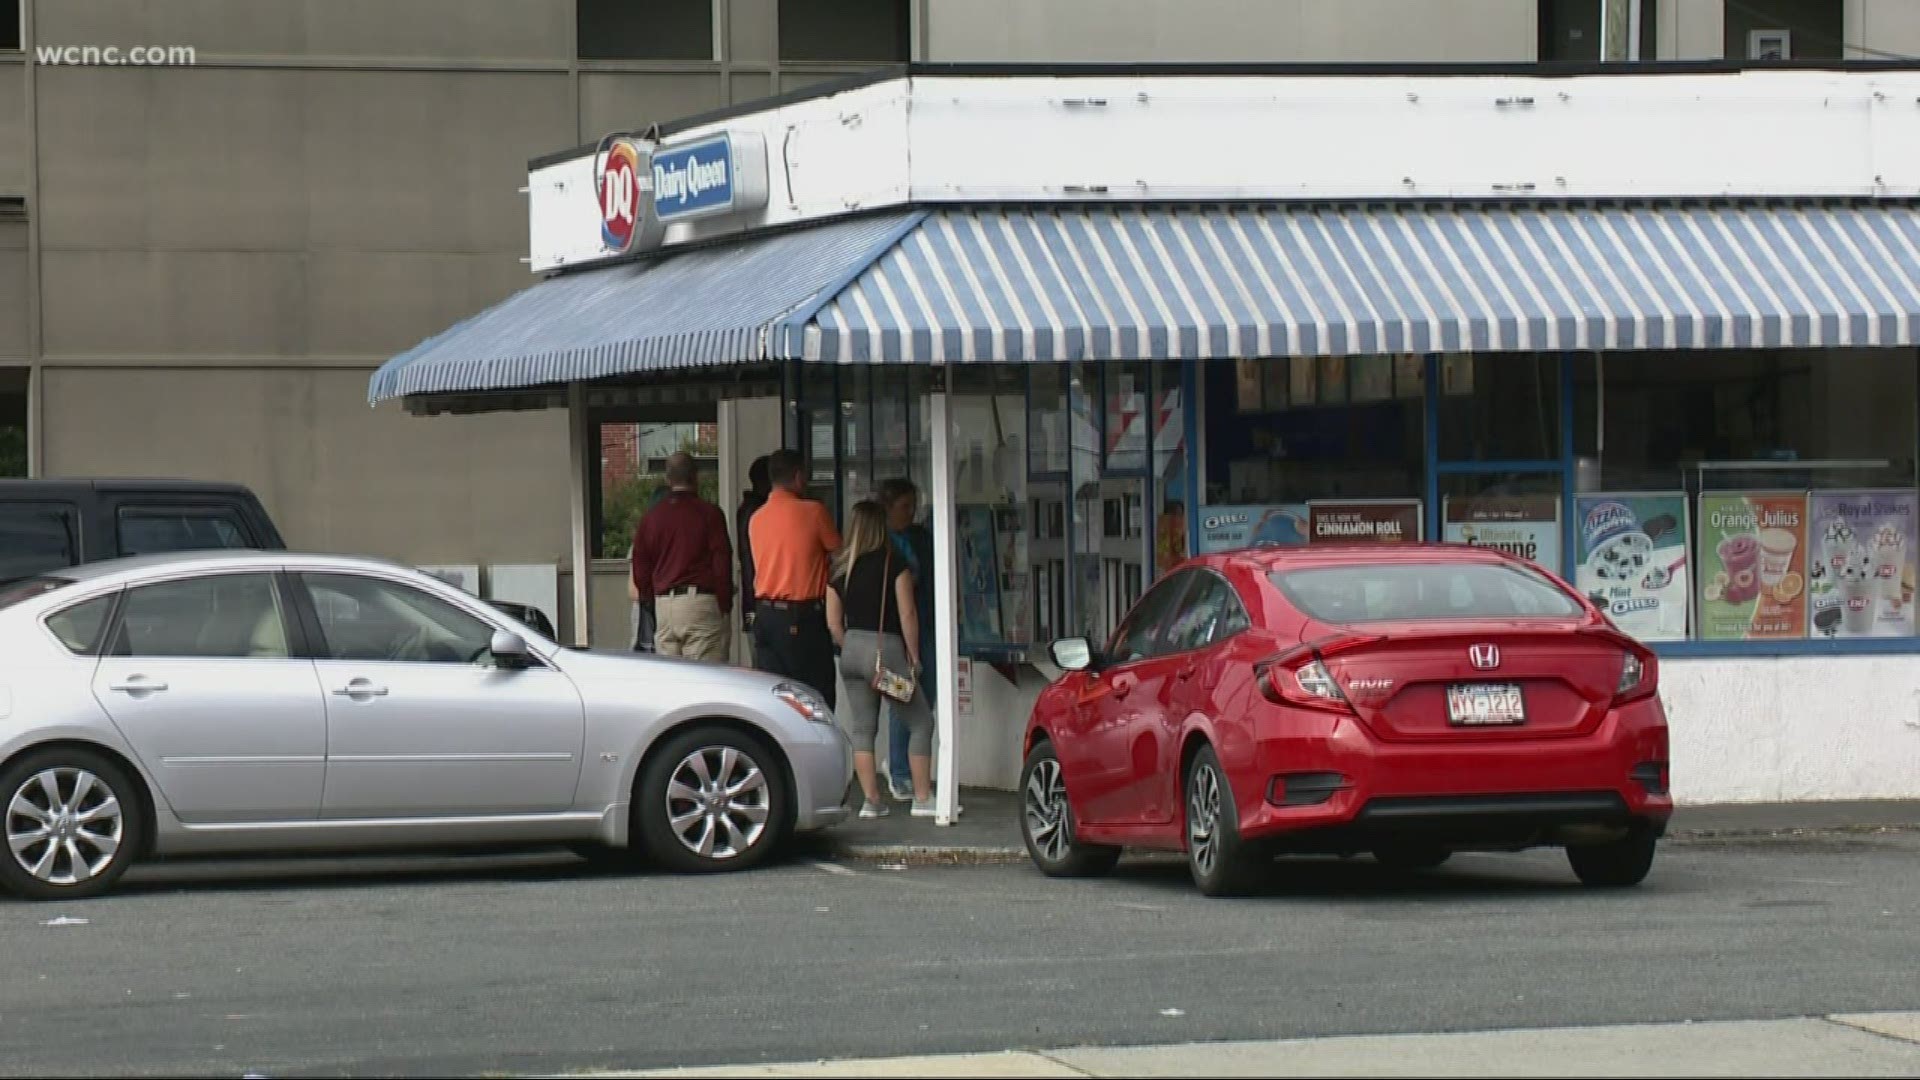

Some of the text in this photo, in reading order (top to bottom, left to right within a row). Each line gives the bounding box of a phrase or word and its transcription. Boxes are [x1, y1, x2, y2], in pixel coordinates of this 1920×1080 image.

[654, 155, 727, 204] Dairy Queen
[605, 164, 633, 224] DQ
[1837, 501, 1871, 517] Royal
[1203, 513, 1248, 529] OREO
[1316, 518, 1403, 535] CINNAMON ROLL
[1711, 510, 1799, 530] Orange Julius
[1609, 586, 1632, 598] Mint
[1611, 598, 1660, 616] OREO
[1349, 679, 1394, 690] CIVIC
